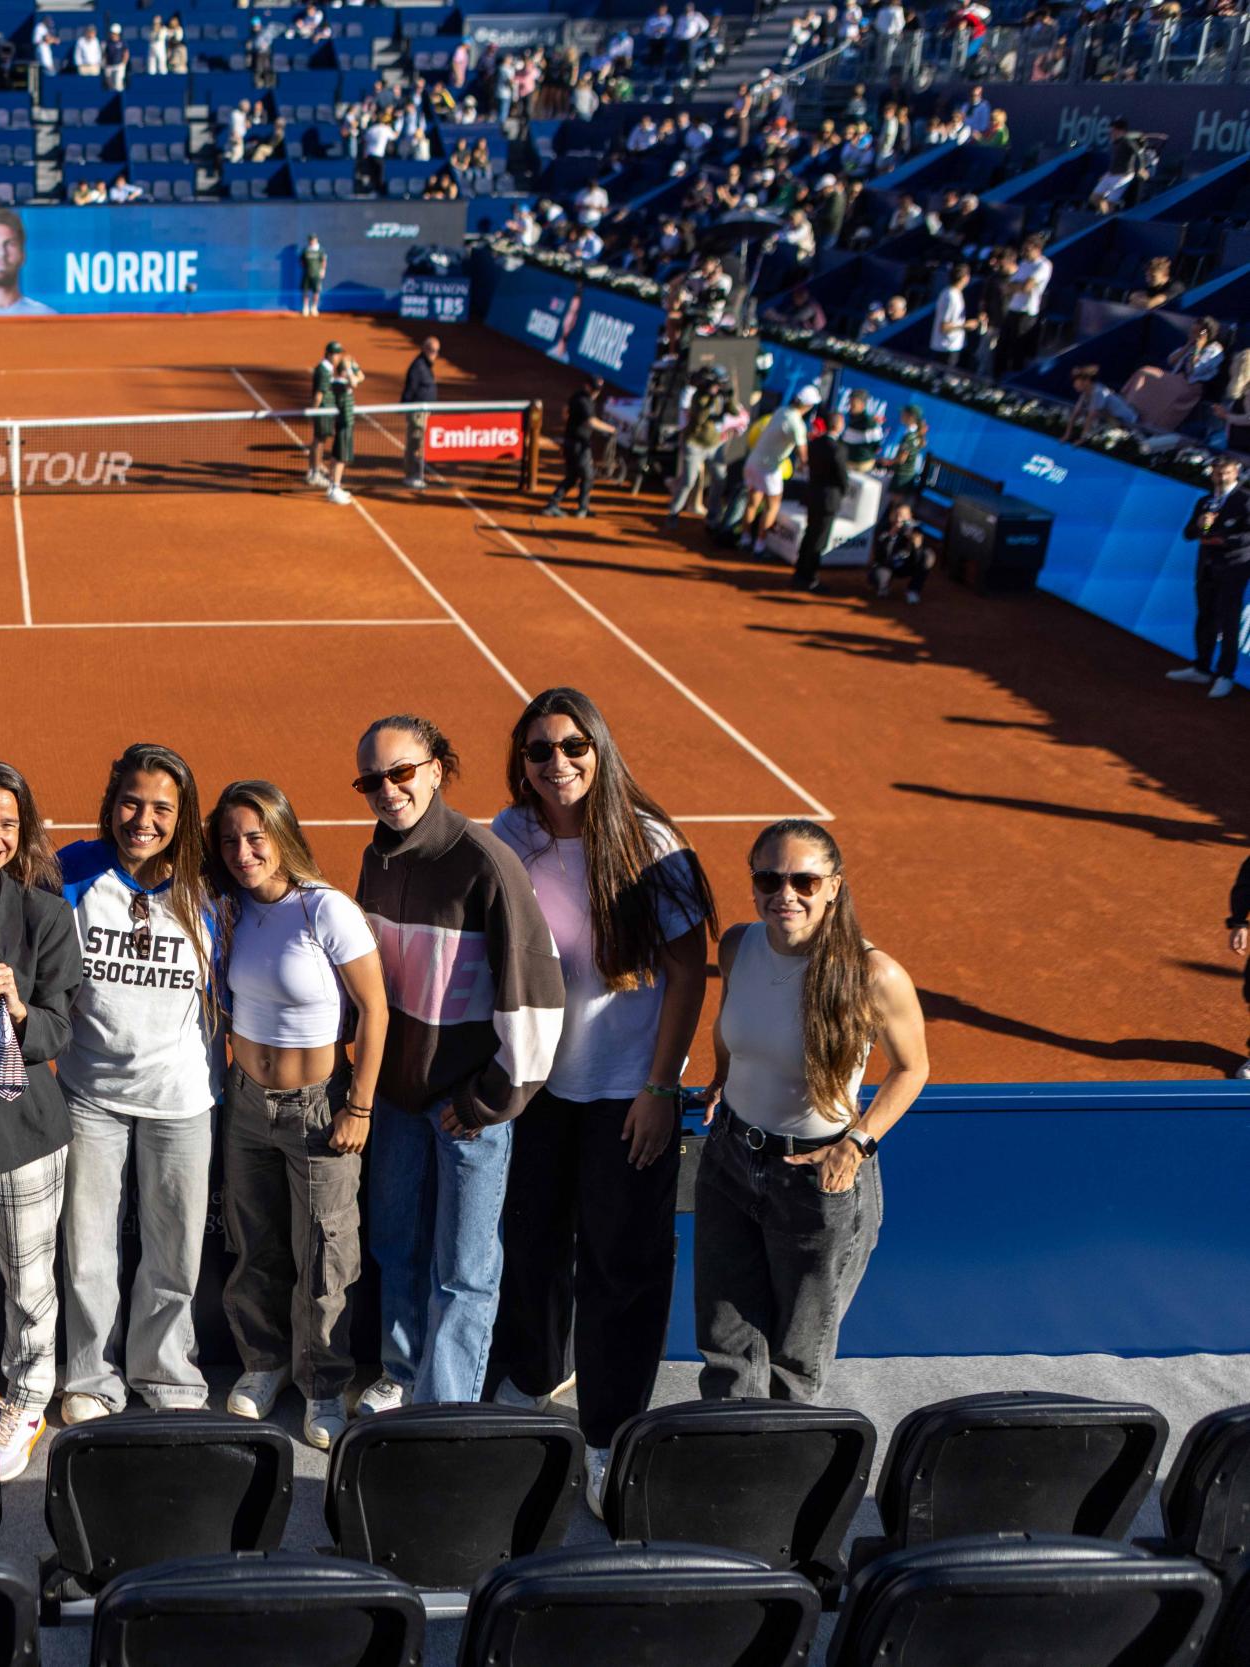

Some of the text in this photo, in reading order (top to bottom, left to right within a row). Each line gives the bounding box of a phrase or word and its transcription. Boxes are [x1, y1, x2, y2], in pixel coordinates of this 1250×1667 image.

[1057, 105, 1116, 146] Haie
[1193, 109, 1250, 152] Hai
[65, 249, 199, 294] NORRIE
[578, 310, 636, 372] NORRIE
[430, 425, 519, 449] Emirates
[23, 452, 134, 486] TOUR
